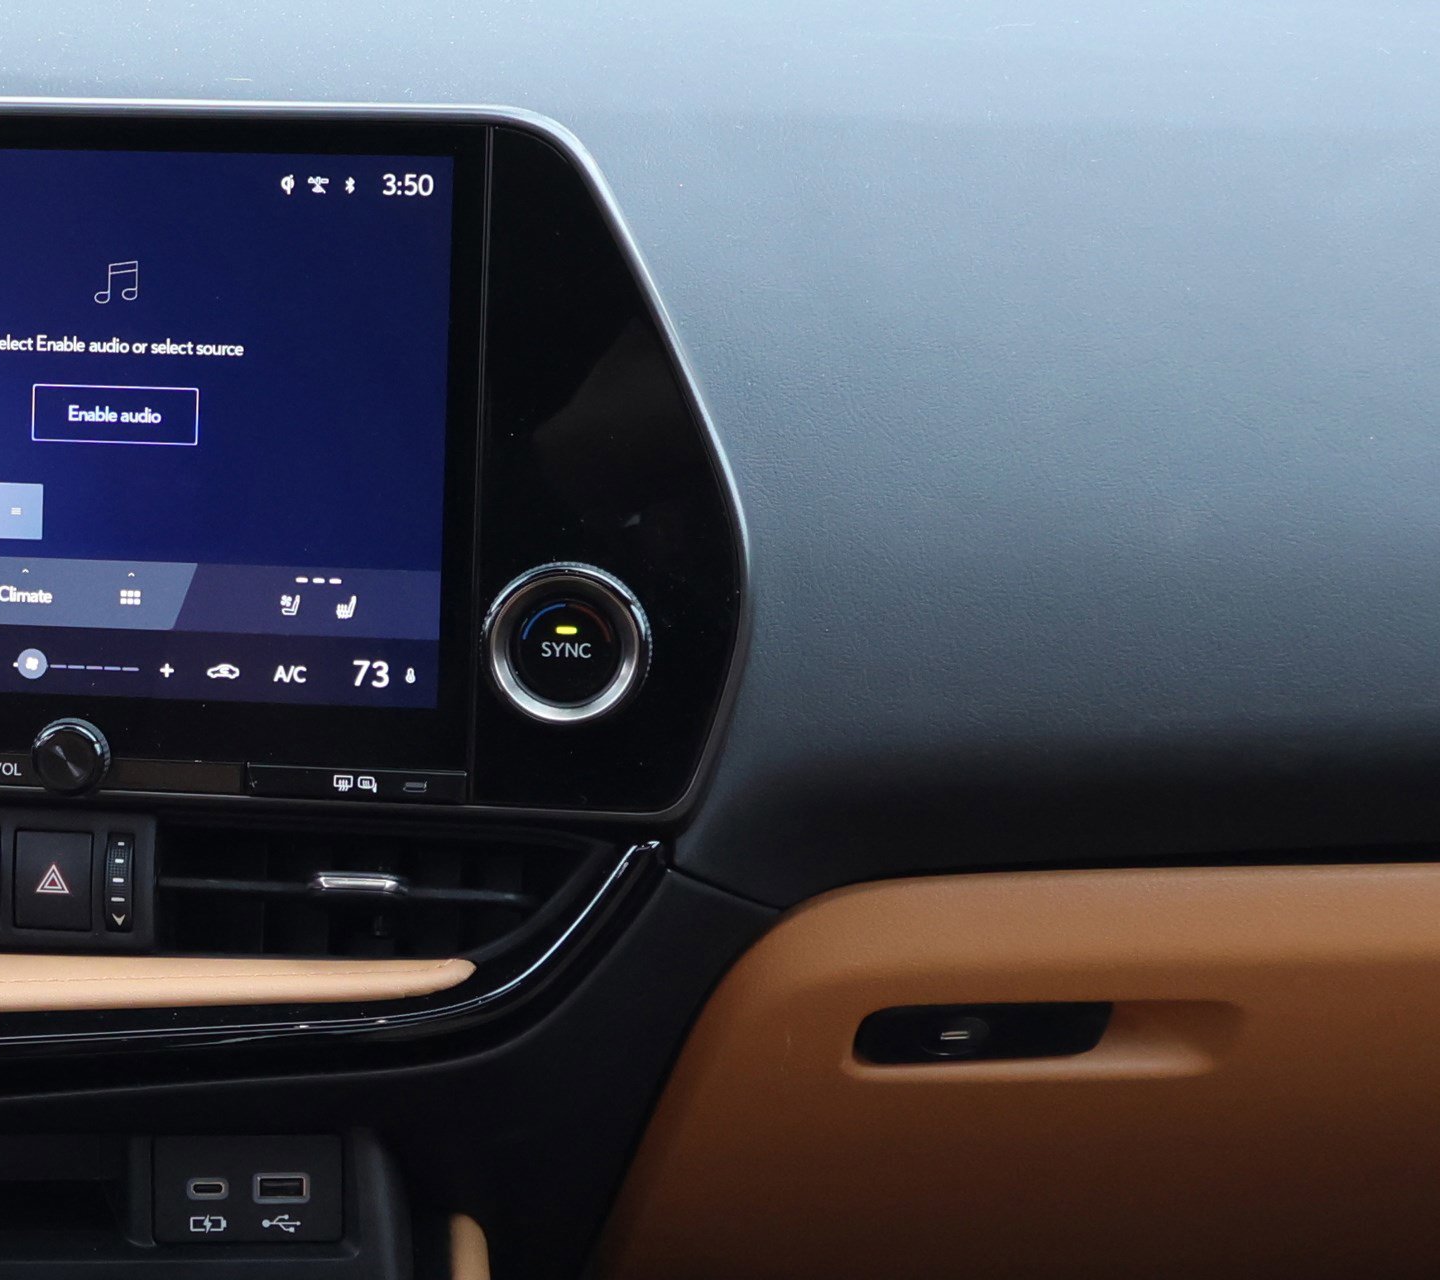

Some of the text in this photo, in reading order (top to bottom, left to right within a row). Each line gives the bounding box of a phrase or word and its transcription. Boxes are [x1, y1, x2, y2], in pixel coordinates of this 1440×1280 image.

[382, 174, 434, 196] 3:50
[36, 334, 86, 353] Enable
[89, 336, 129, 354] audio
[132, 342, 148, 355] or
[151, 337, 193, 355] select
[196, 343, 245, 356] source
[67, 405, 162, 424] Enable audio
[541, 642, 592, 660] SYNC
[273, 664, 307, 685] A/C
[352, 659, 390, 688] 73
